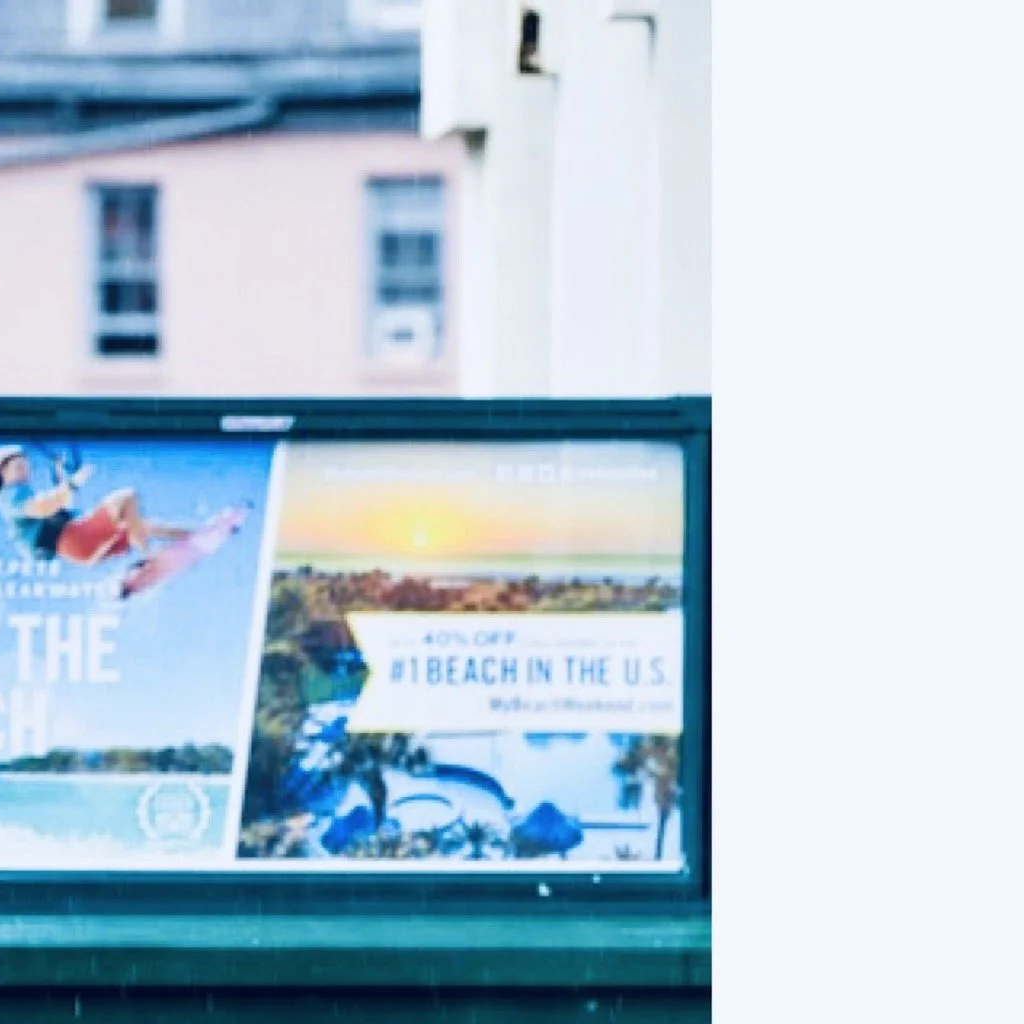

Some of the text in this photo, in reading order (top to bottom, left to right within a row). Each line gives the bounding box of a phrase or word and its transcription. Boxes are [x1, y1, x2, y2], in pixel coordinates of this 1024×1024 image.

[8, 613, 120, 683] THE
[423, 631, 467, 645] 40%
[474, 631, 516, 645] OFF
[390, 656, 418, 684] #1
[426, 656, 517, 685] BEACH
[527, 656, 552, 684] IN
[565, 656, 609, 684] THE
